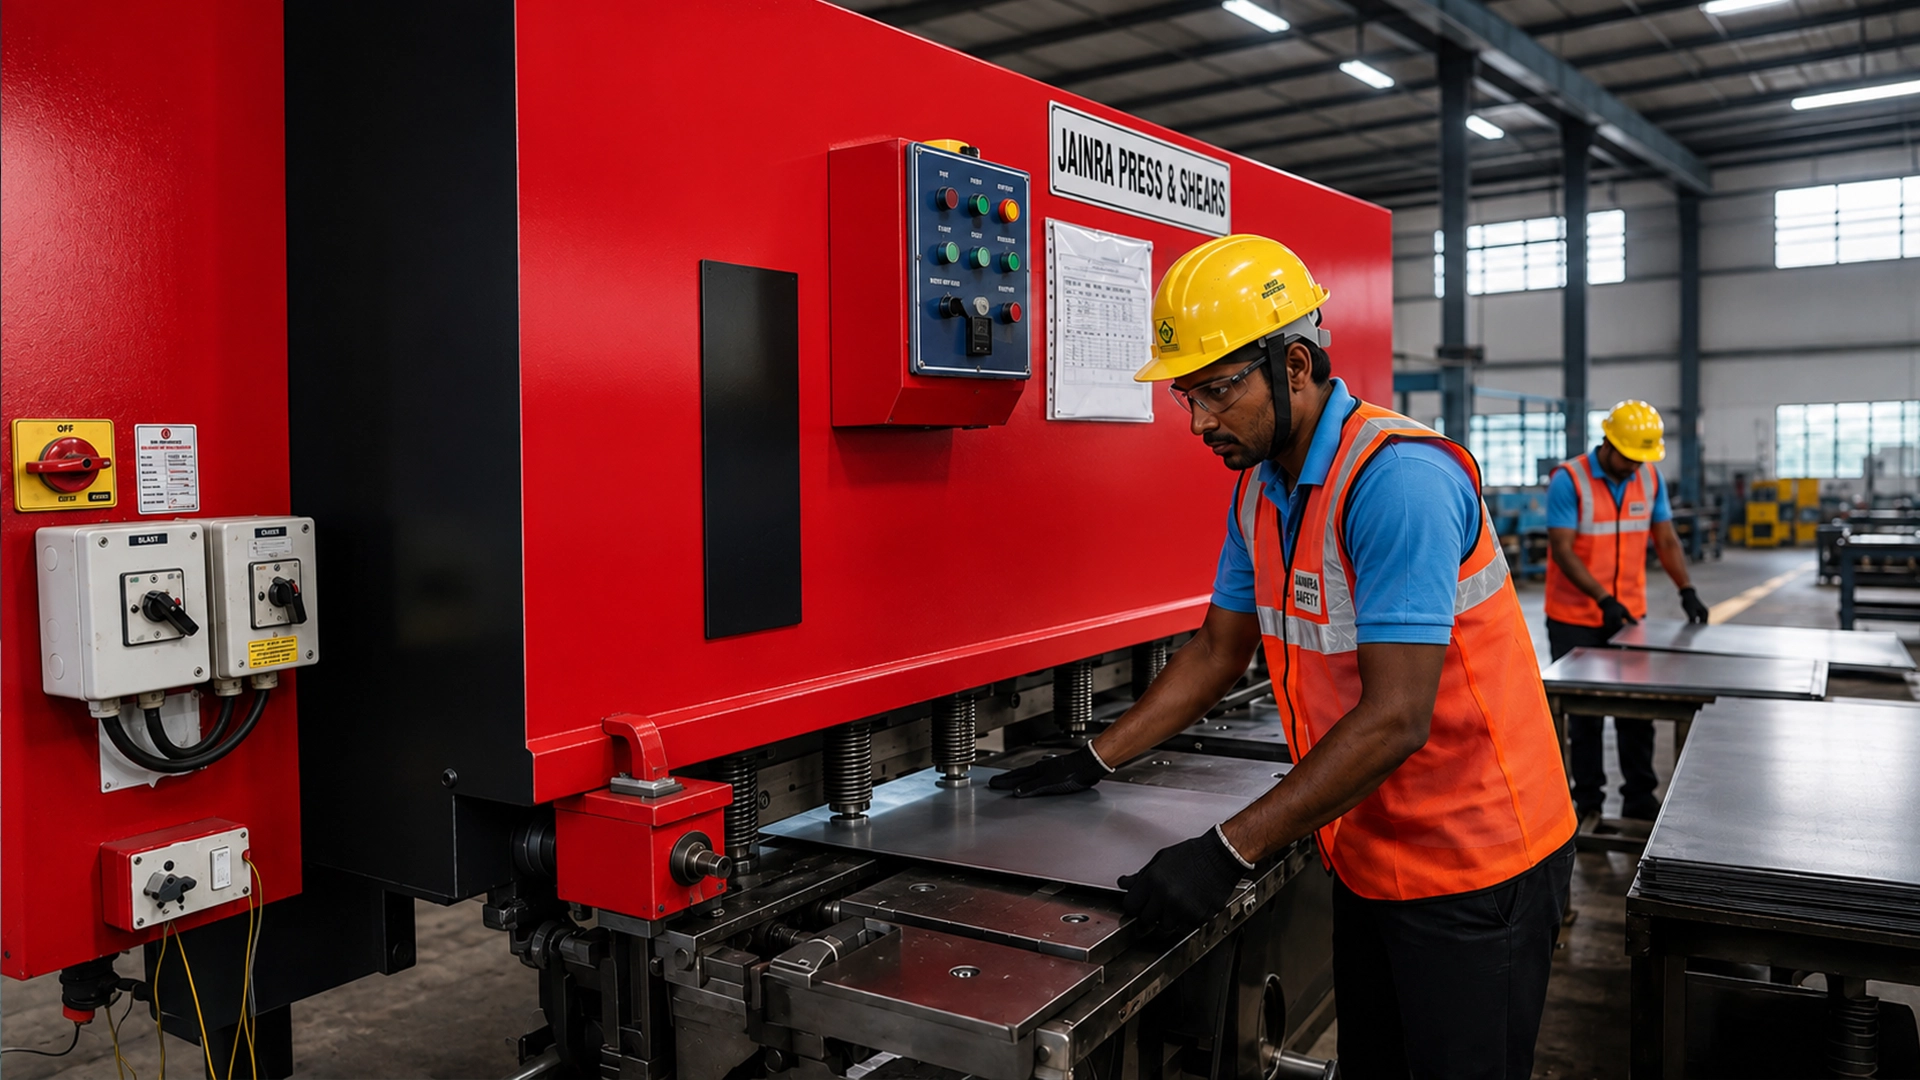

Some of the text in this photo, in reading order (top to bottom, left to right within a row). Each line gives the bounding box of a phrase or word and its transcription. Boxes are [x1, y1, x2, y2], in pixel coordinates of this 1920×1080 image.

[1058, 128, 1226, 217] JAINRA PRESS & SHEARS
[57, 424, 73, 432] OFF
[138, 535, 158, 543] BLAST
